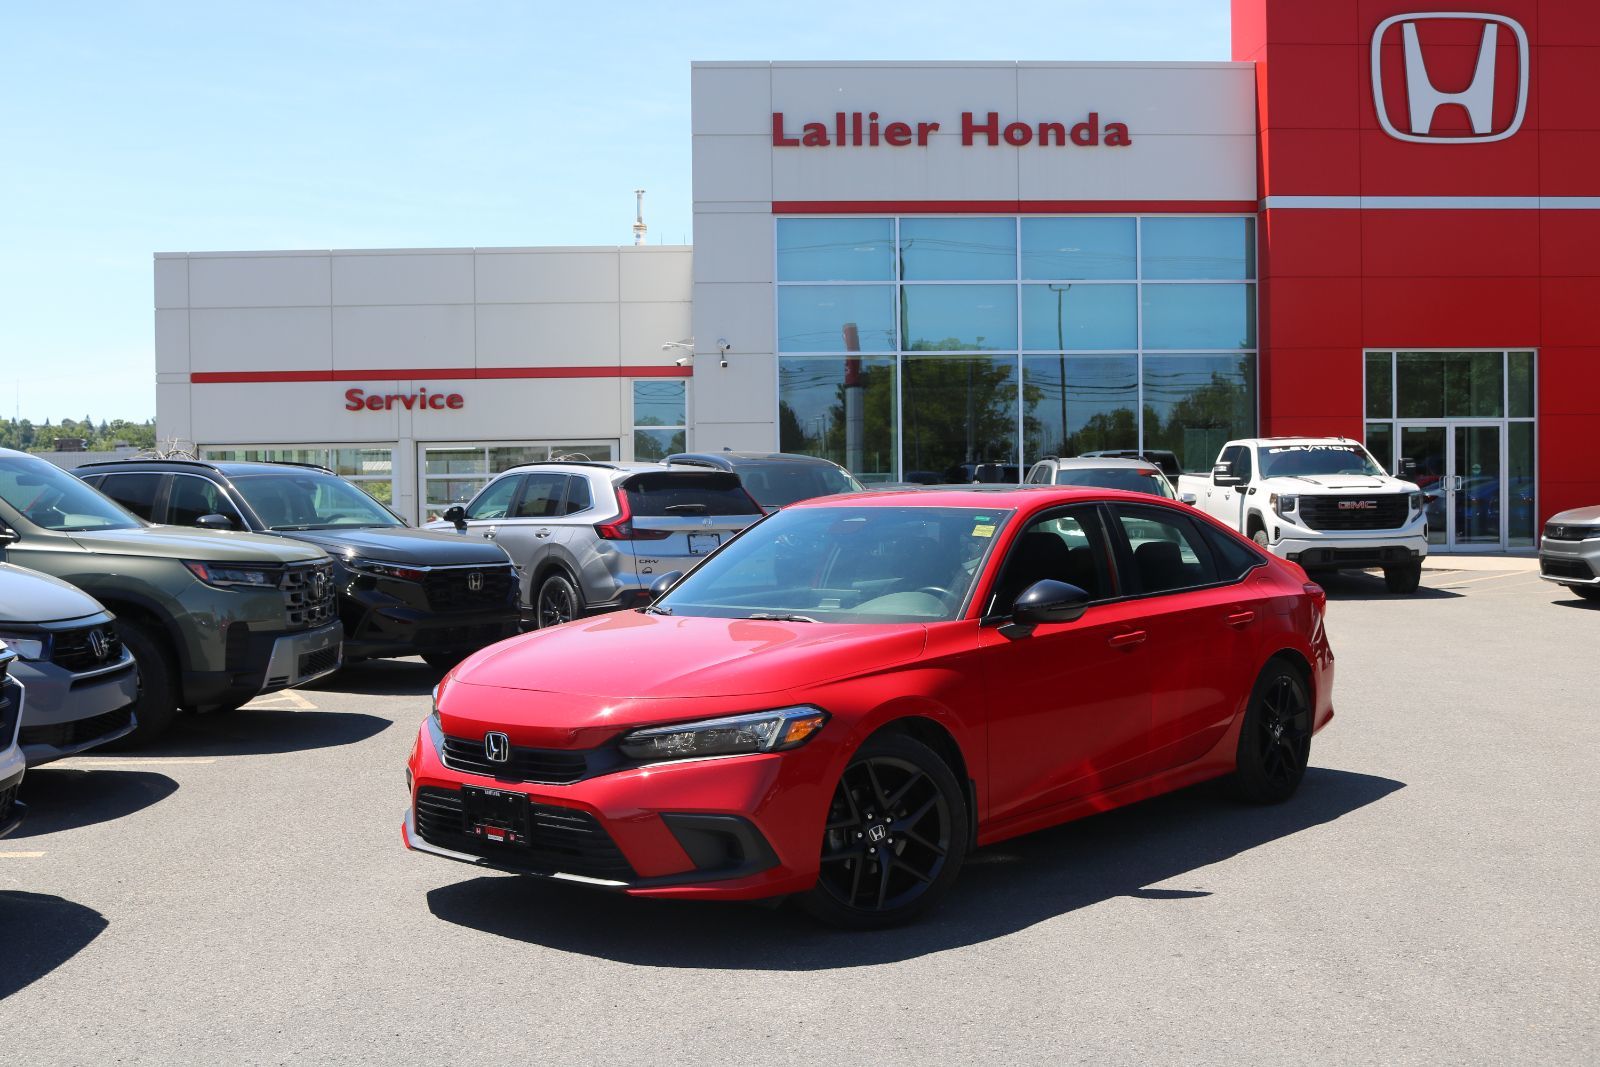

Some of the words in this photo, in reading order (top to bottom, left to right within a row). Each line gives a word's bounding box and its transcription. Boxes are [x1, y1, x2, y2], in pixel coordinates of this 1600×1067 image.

[772, 111, 940, 147] Lallier
[961, 111, 1132, 147] Honda
[344, 387, 464, 412] Service
[1268, 444, 1355, 454] ELEVATION
[1338, 500, 1378, 510] GMC
